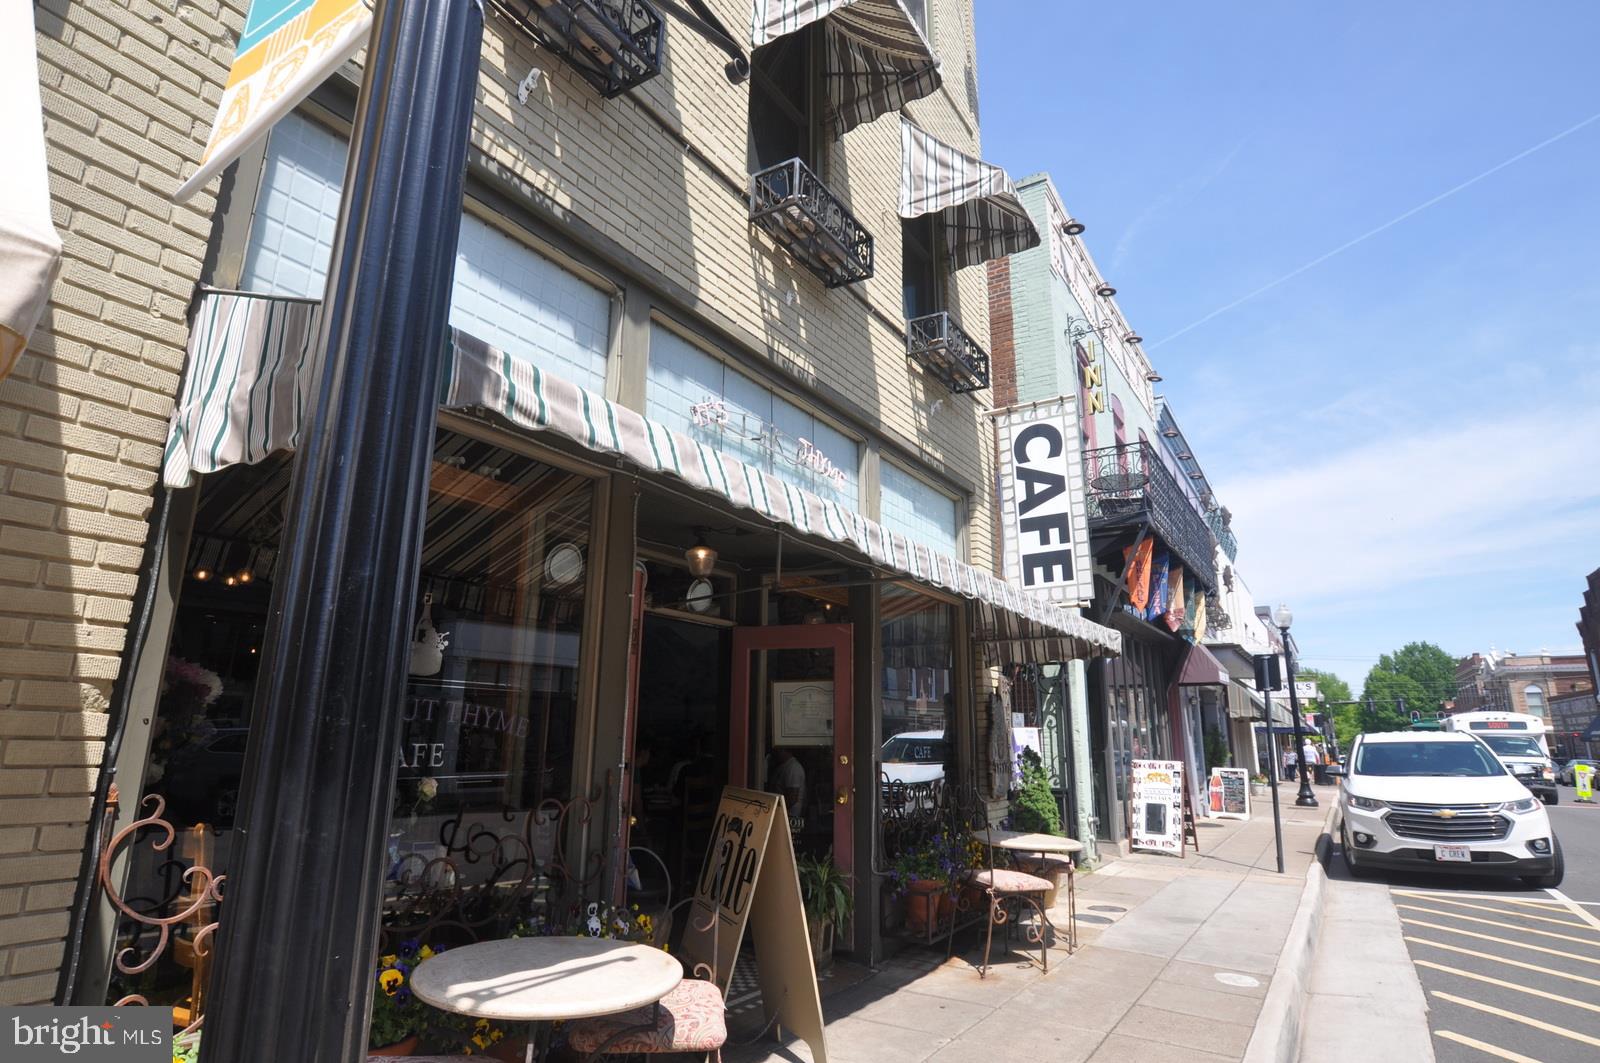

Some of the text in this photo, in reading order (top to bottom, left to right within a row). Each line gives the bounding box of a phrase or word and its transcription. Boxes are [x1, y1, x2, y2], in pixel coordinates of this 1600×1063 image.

[1084, 340, 1105, 416] INN
[1013, 423, 1075, 587] CAFE
[446, 700, 530, 738] THYME
[914, 746, 932, 759] CAFE
